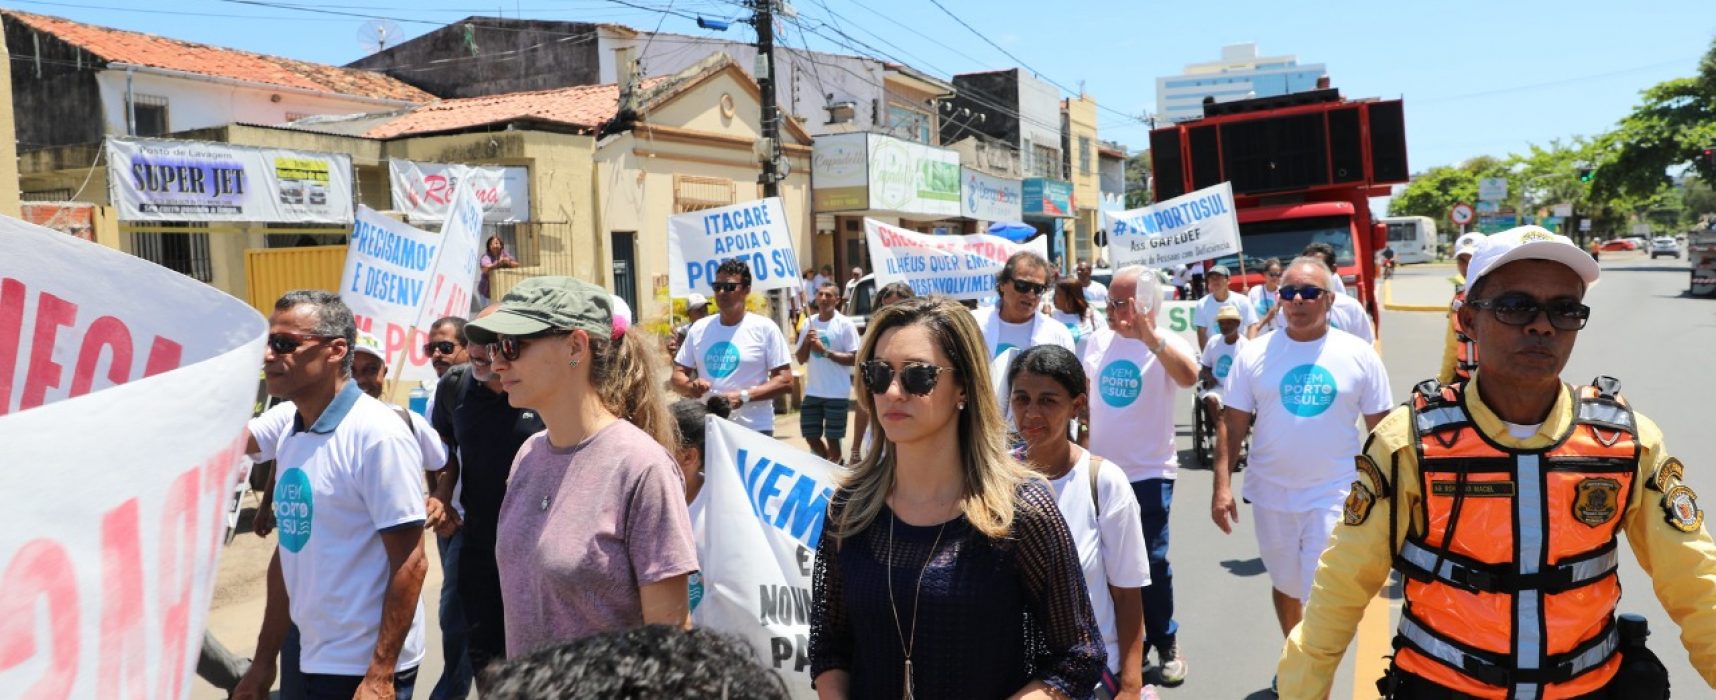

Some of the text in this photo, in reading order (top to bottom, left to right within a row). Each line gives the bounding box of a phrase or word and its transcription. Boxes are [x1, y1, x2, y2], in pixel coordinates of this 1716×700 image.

[139, 145, 233, 160] Posto de Lavagem
[132, 162, 206, 194] SUPER
[212, 167, 245, 197] JET
[703, 200, 772, 236] ITACARÉ
[714, 230, 771, 255] APOIA O
[886, 251, 926, 275] ILHÉUS
[930, 255, 960, 273] QUER
[351, 261, 363, 292] E
[1111, 368, 1133, 378] VEM
[1292, 373, 1324, 384] VEM
[1102, 376, 1138, 389] PORTO
[1284, 384, 1332, 394] PORTO
[1109, 387, 1128, 398] SUL
[1294, 395, 1319, 405] SUL
[736, 447, 833, 550] VEM
